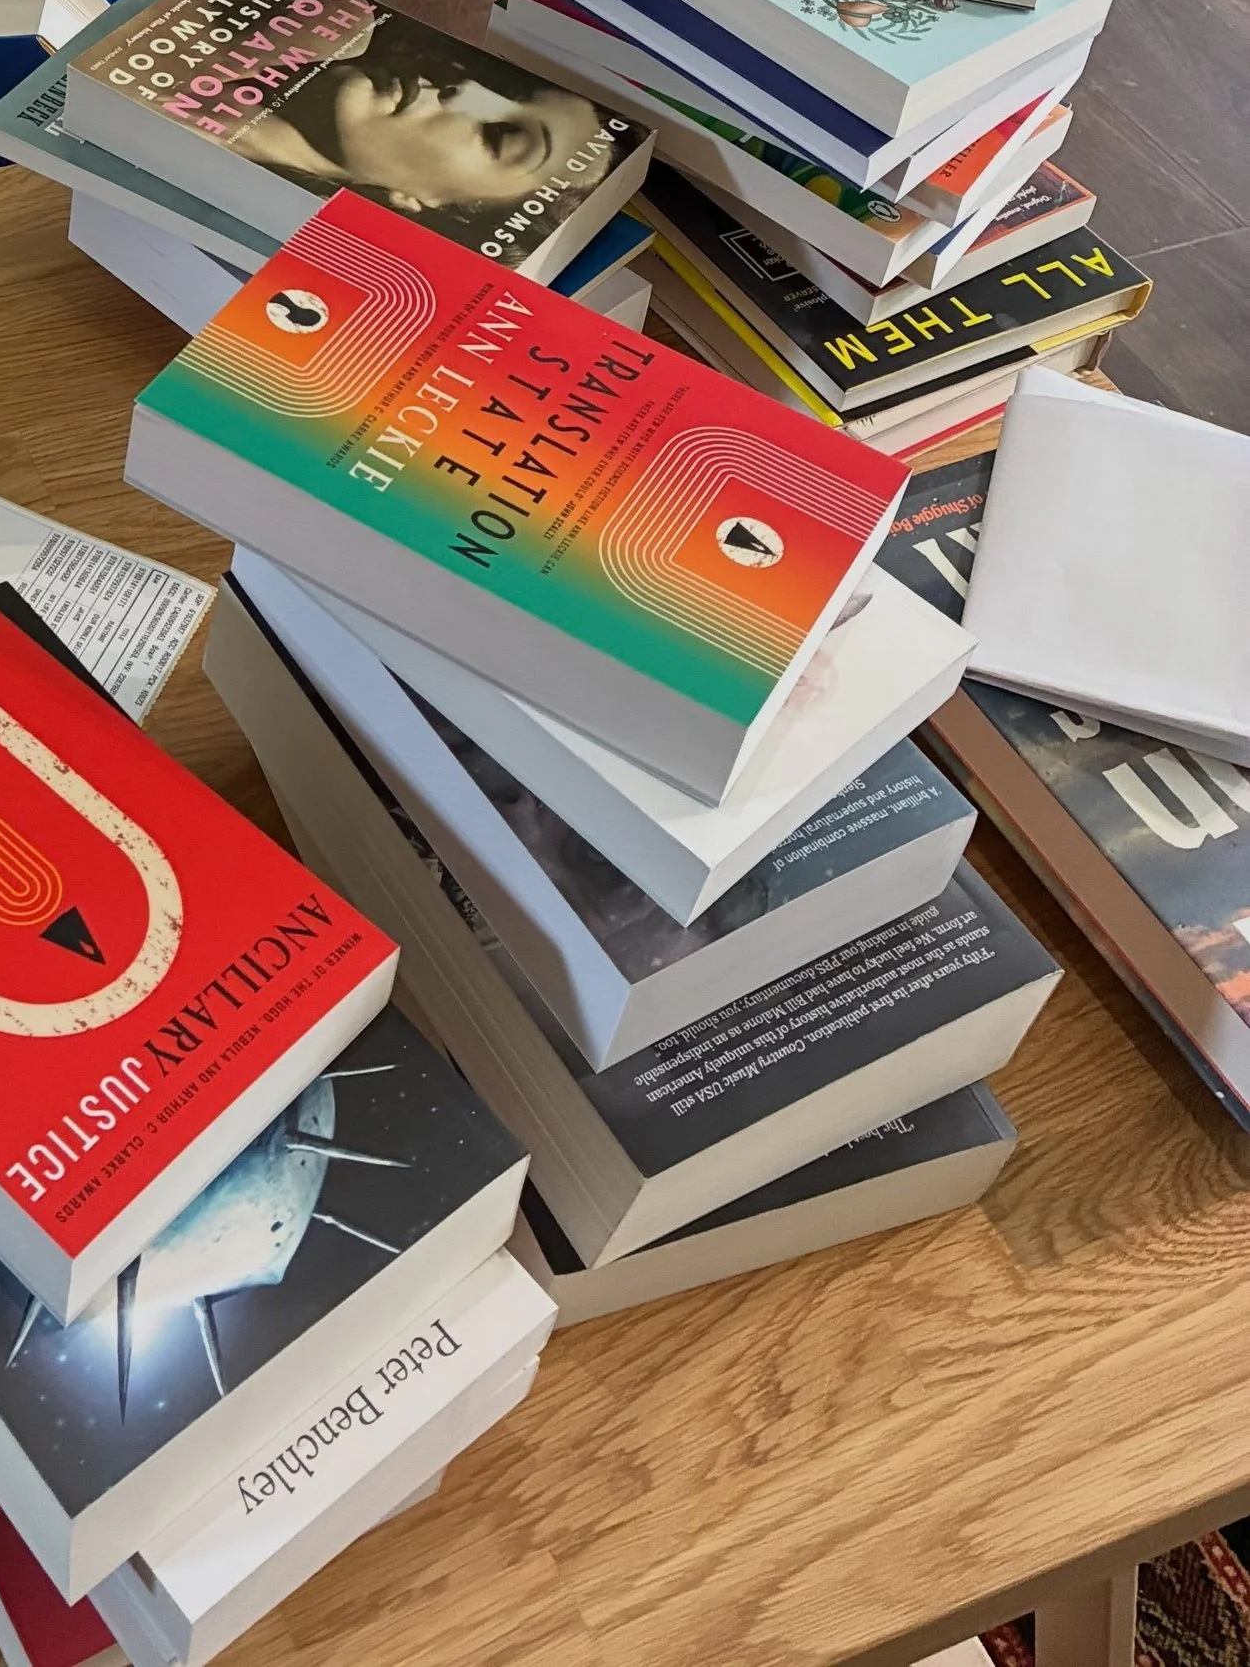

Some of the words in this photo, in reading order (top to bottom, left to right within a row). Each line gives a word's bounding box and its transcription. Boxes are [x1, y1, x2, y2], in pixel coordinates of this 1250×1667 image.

[137, 71, 175, 102] OF
[195, 44, 319, 135] WHOLE
[563, 116, 631, 175] DAVID
[478, 178, 573, 260] THOMSO
[1000, 247, 1117, 301] ALL
[456, 290, 536, 365] ANN
[824, 295, 994, 373] THEM
[348, 364, 476, 493] LECKIE
[433, 345, 571, 487] STATE
[447, 339, 656, 569] TRANSLATION
[141, 893, 334, 1078] ANCILLARY
[892, 988, 910, 1000] its
[908, 976, 935, 993] after
[933, 958, 963, 980] years
[801, 1002, 870, 1044] publication,
[872, 995, 895, 1013] first
[722, 1063, 760, 1089] Music
[757, 1040, 806, 1067] Country
[670, 1095, 696, 1117] still
[697, 1081, 725, 1103] USA
[5, 1055, 152, 1203] JUSTICE
[374, 1317, 464, 1398] Peter
[237, 1384, 385, 1515] Benchley
